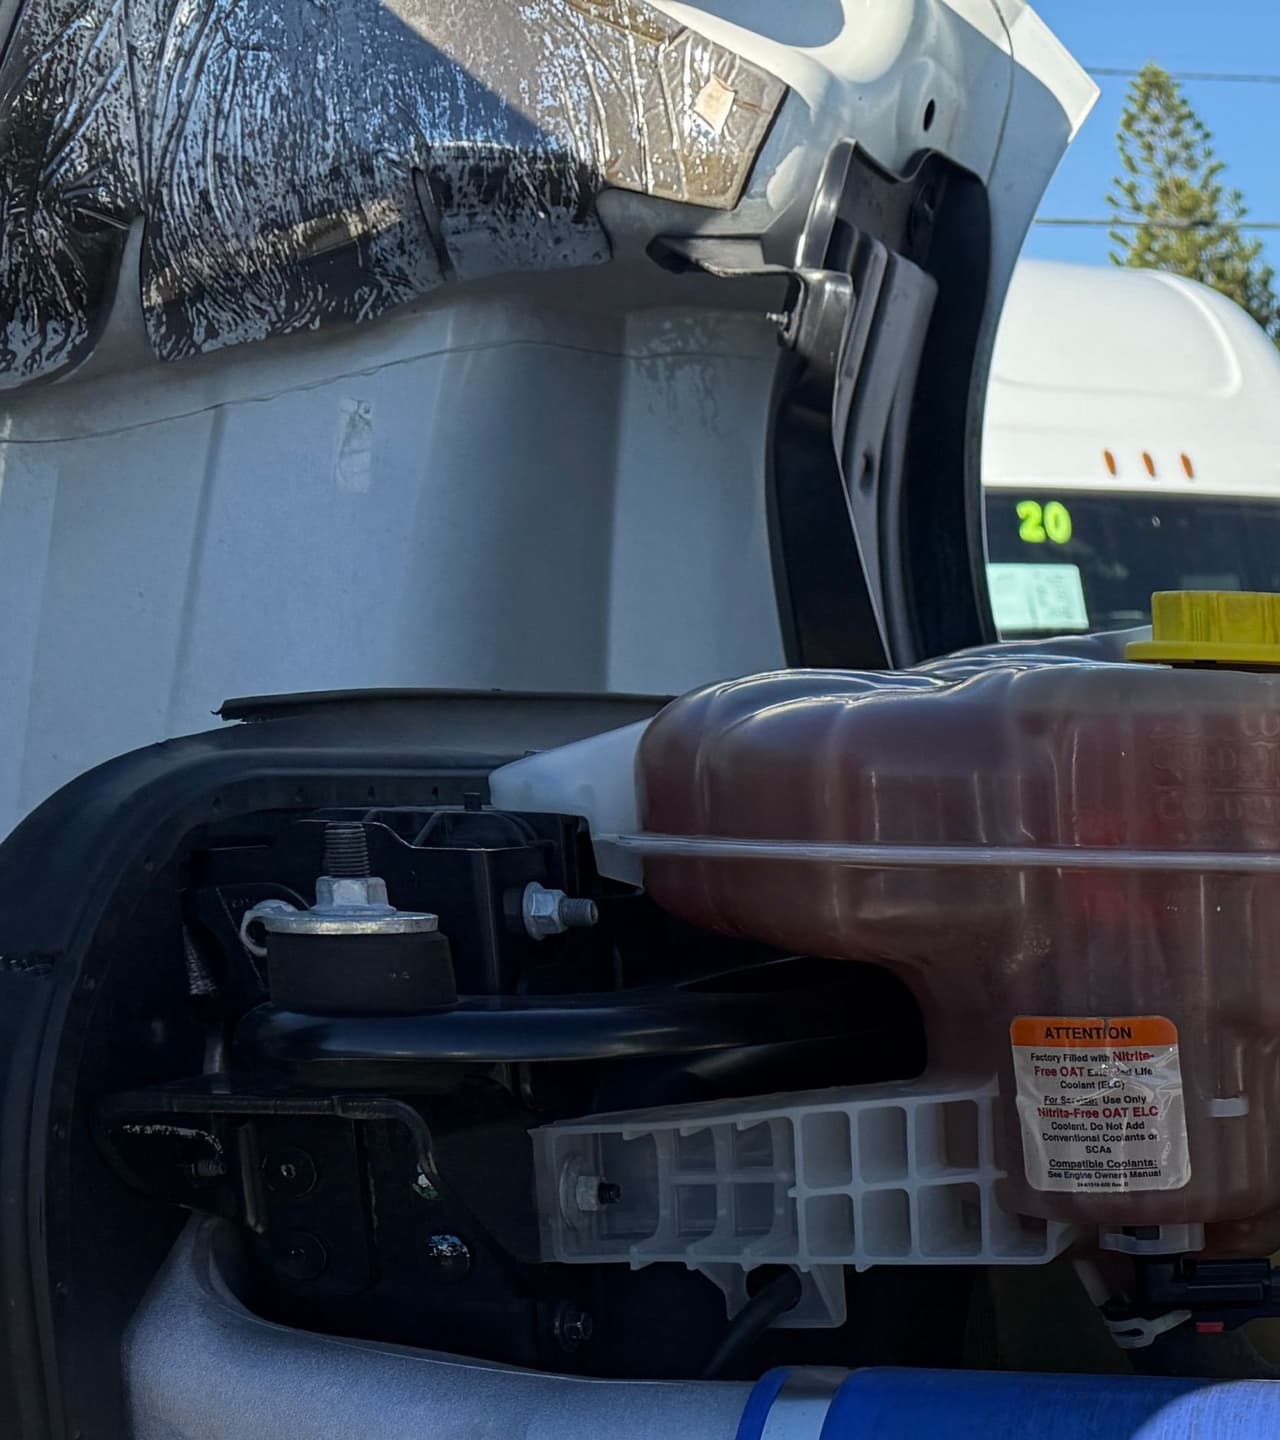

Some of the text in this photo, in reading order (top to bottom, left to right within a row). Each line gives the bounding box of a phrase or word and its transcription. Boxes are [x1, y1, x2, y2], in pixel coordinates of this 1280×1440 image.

[1016, 500, 1072, 545] 20
[1031, 1051, 1156, 1063] Factory Filled with Nitrite-
[1034, 1067, 1153, 1077] Free OAT Life
[1060, 1080, 1095, 1089] Coolant
[1103, 1096, 1122, 1104] Use
[1124, 1095, 1147, 1105] Only
[1038, 1106, 1159, 1118] Nitrite-Free OAT ELC
[1090, 1122, 1103, 1130] Do
[1106, 1121, 1123, 1131] Not
[1126, 1121, 1145, 1130] Add
[1042, 1133, 1100, 1142] Conventional
[1085, 1146, 1112, 1154] SCAs
[1049, 1159, 1104, 1169] Compatible
[1048, 1170, 1161, 1179] See Engine Manual
